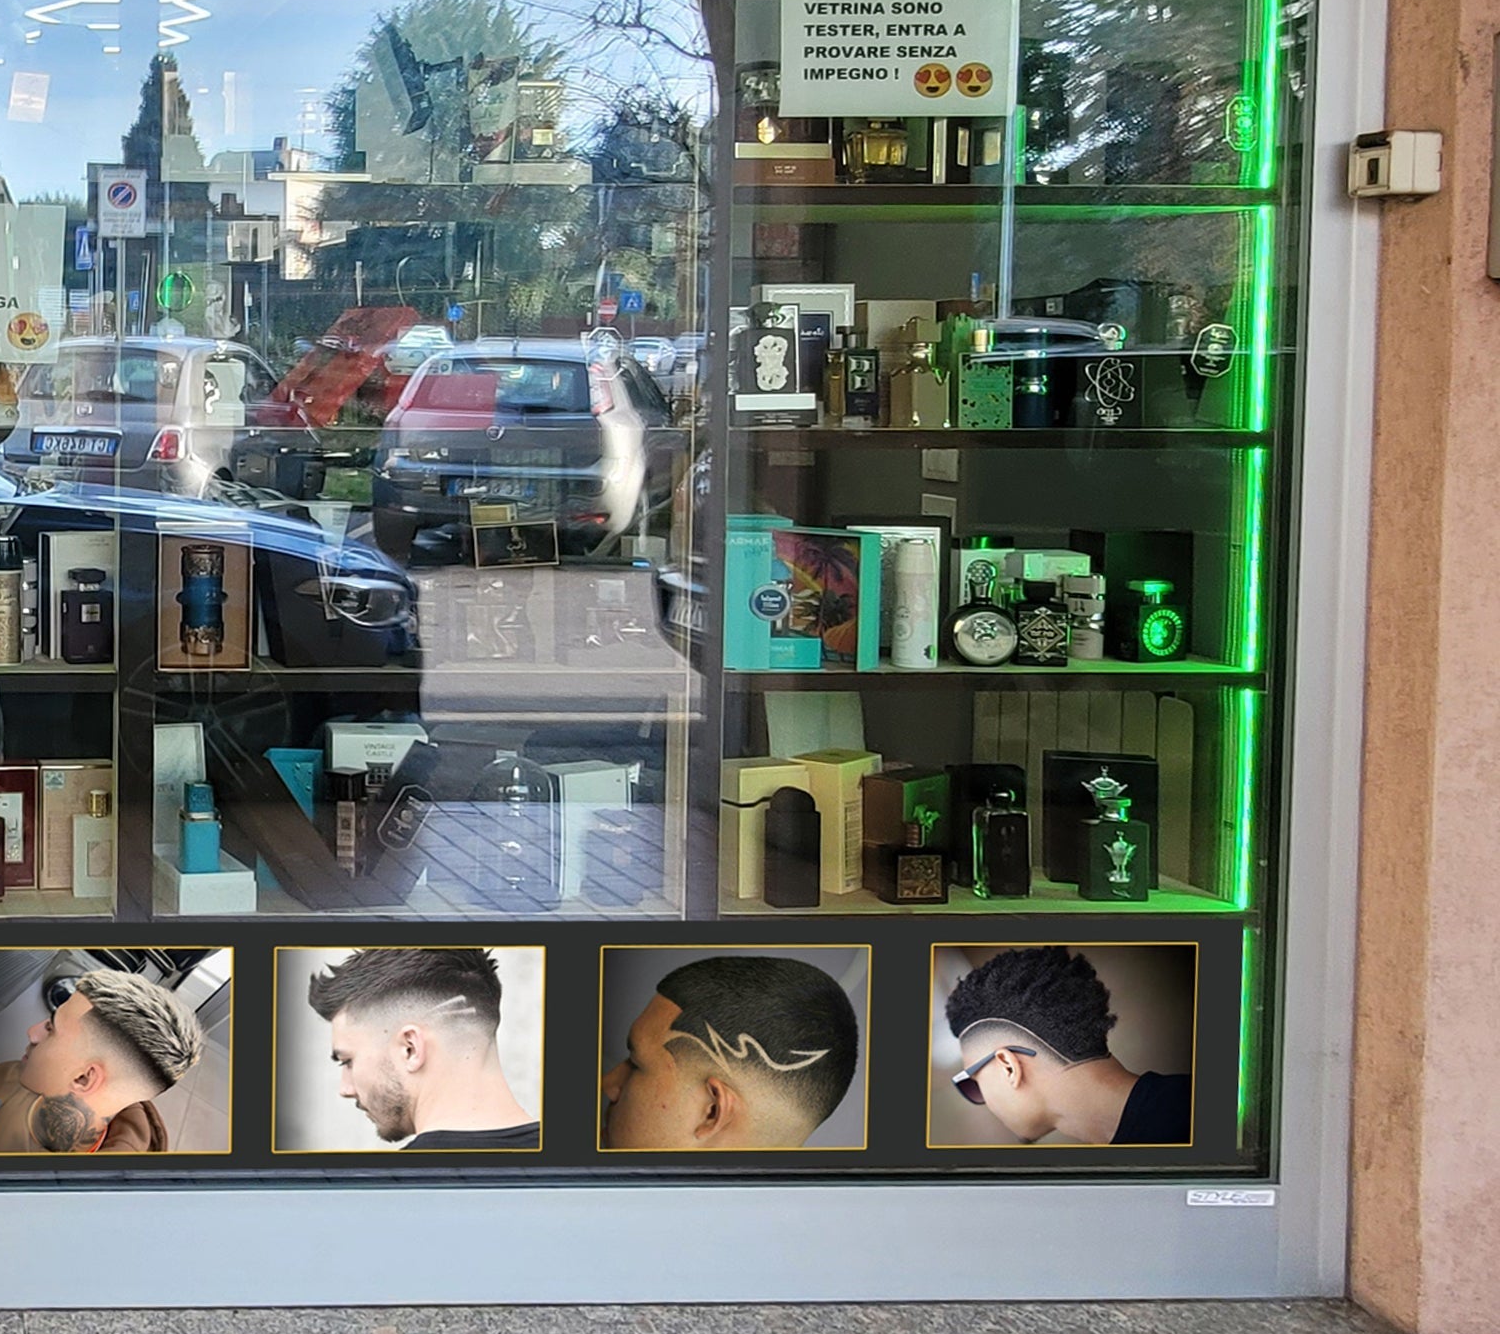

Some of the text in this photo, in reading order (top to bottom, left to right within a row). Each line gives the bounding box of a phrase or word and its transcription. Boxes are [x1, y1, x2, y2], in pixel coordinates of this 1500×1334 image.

[804, 2, 943, 15] VETRINA SONO
[804, 23, 967, 39] TESTER, ENTRA A
[804, 45, 958, 59] PROVARE SENZA
[804, 67, 888, 80] IMPEGNO
